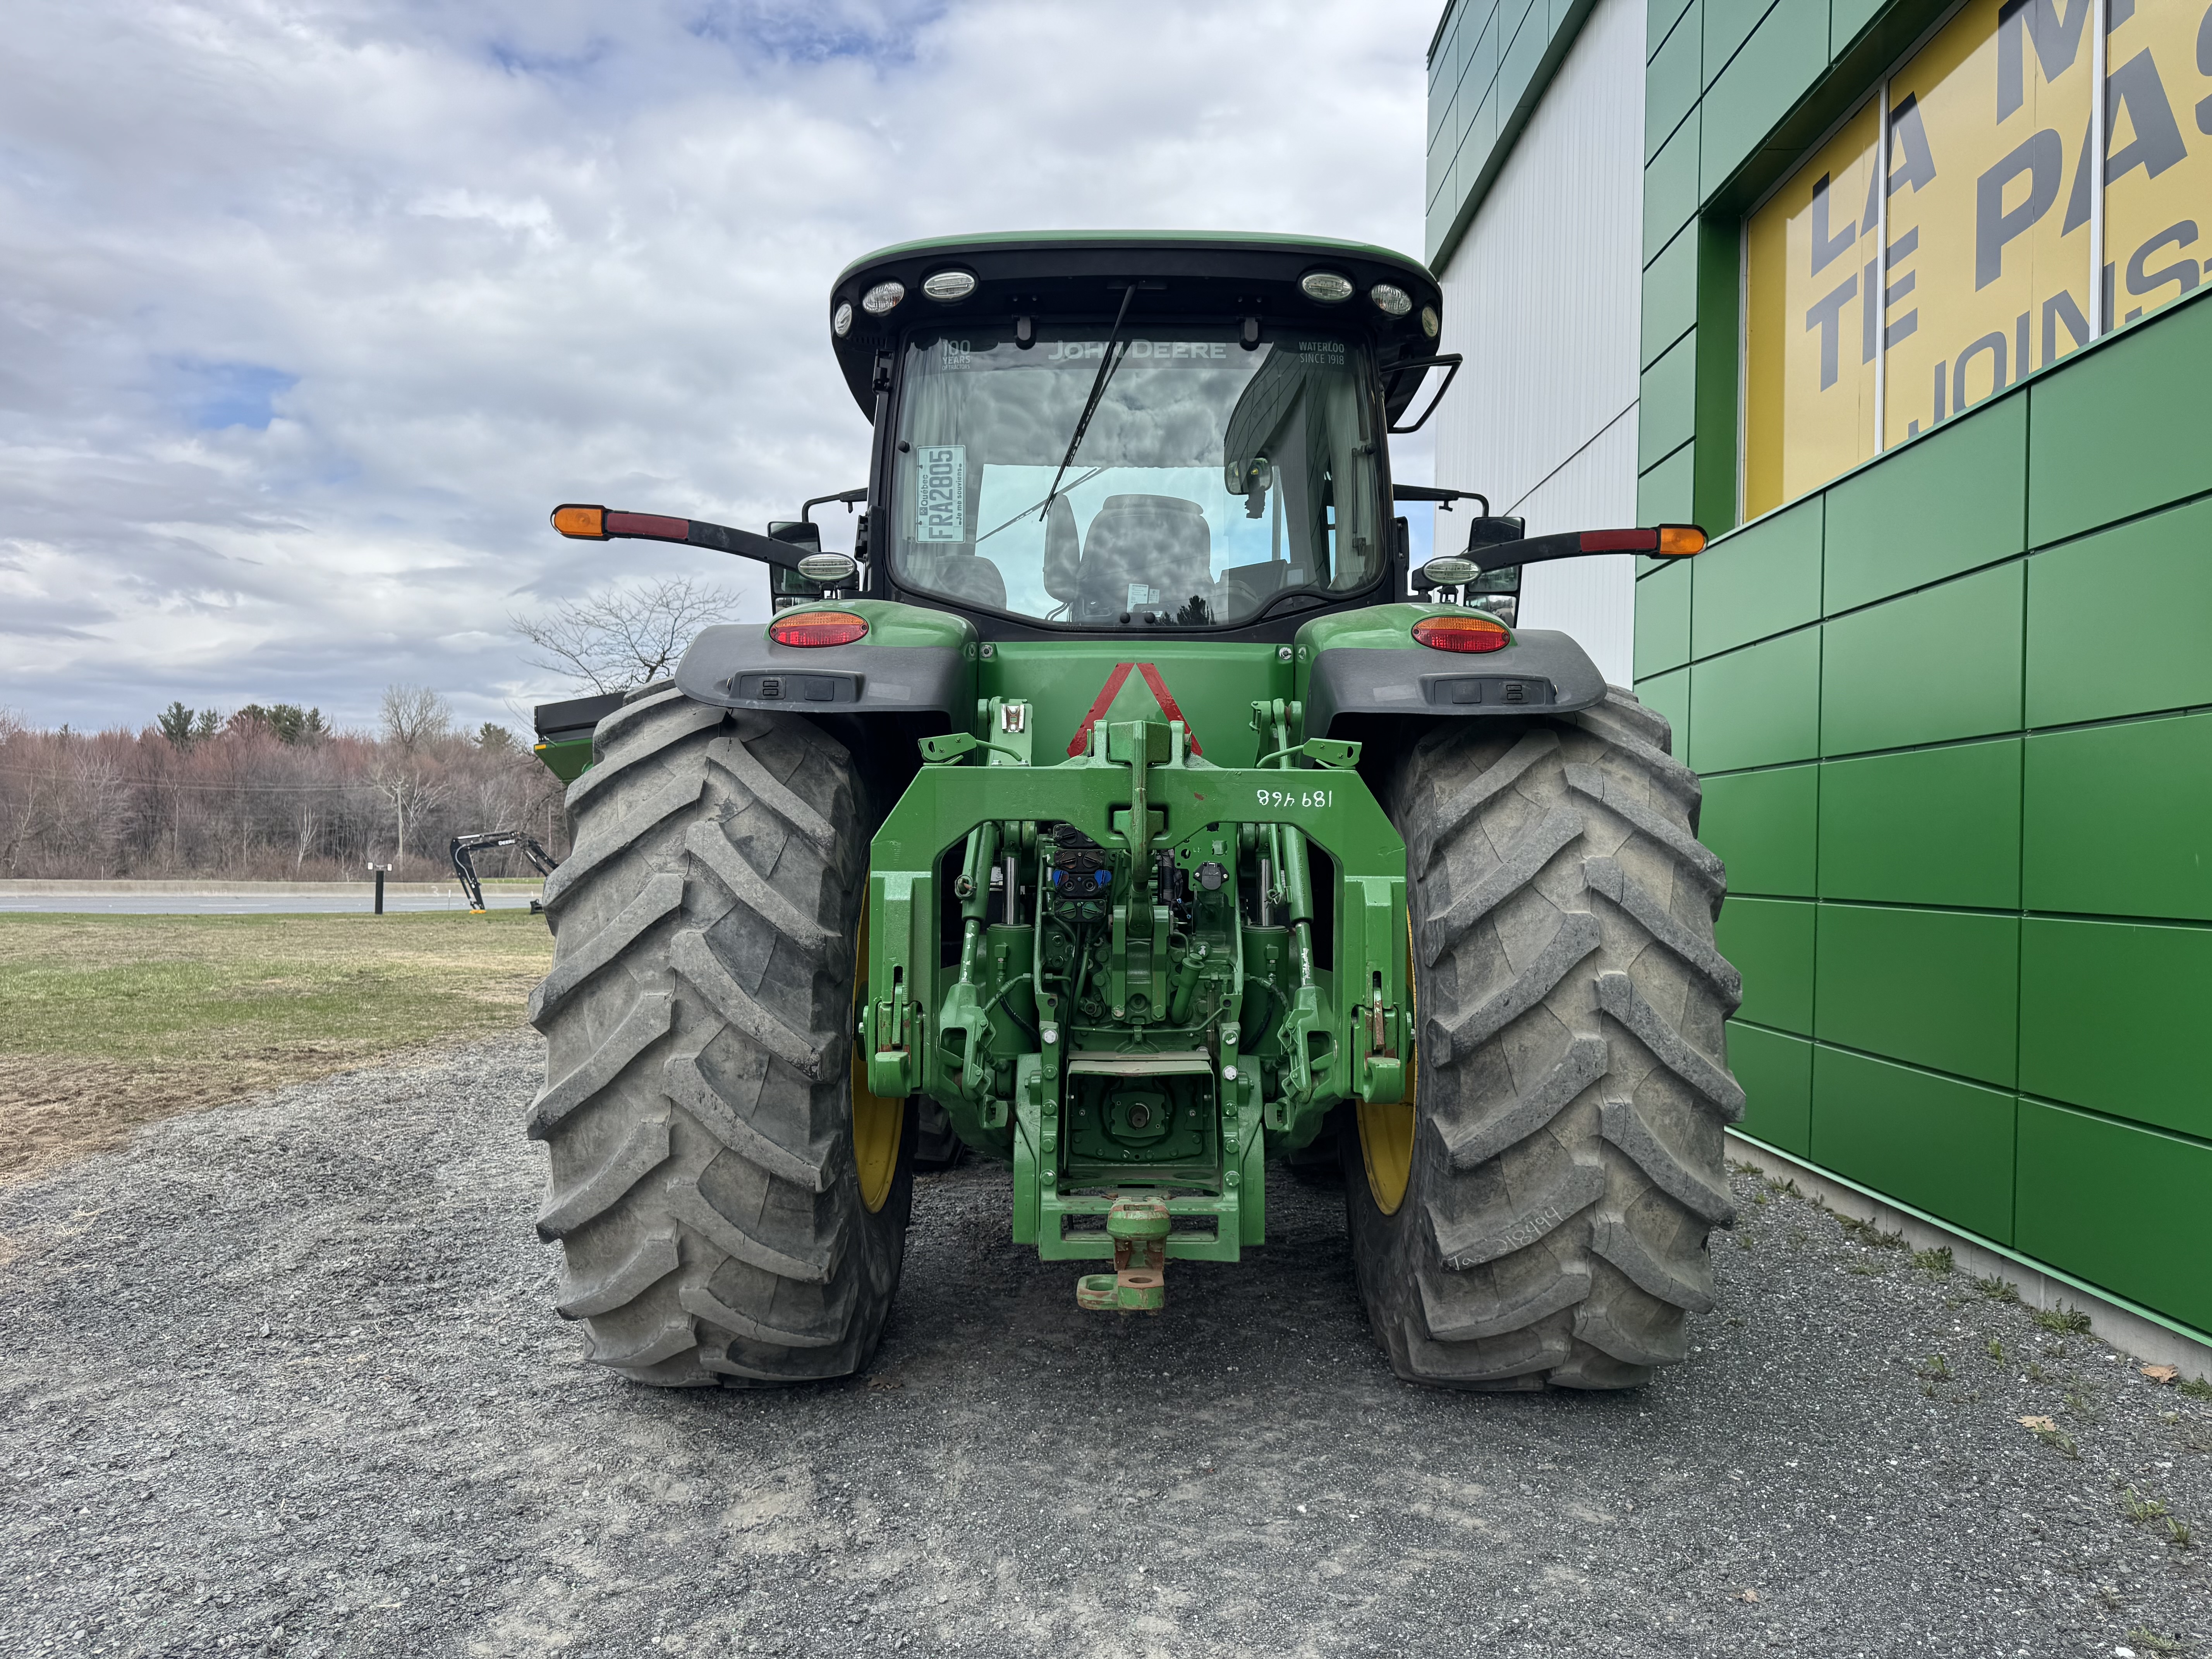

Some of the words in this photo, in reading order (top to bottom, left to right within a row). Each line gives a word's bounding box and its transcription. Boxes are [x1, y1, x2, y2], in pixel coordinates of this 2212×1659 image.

[1811, 91, 1937, 278] LA
[1806, 225, 1919, 393] TE
[1975, 4, 2212, 293] PA
[1908, 220, 2212, 439] JOINS
[943, 340, 970, 356] 100
[1132, 339, 1226, 359] DEERE
[1299, 341, 1345, 353] WATERLOO
[943, 356, 970, 364] YEARS
[1300, 353, 1325, 363] SINCE
[1328, 354, 1344, 365] 1918
[929, 450, 953, 539] FRA2805
[956, 512, 962, 520] Je
